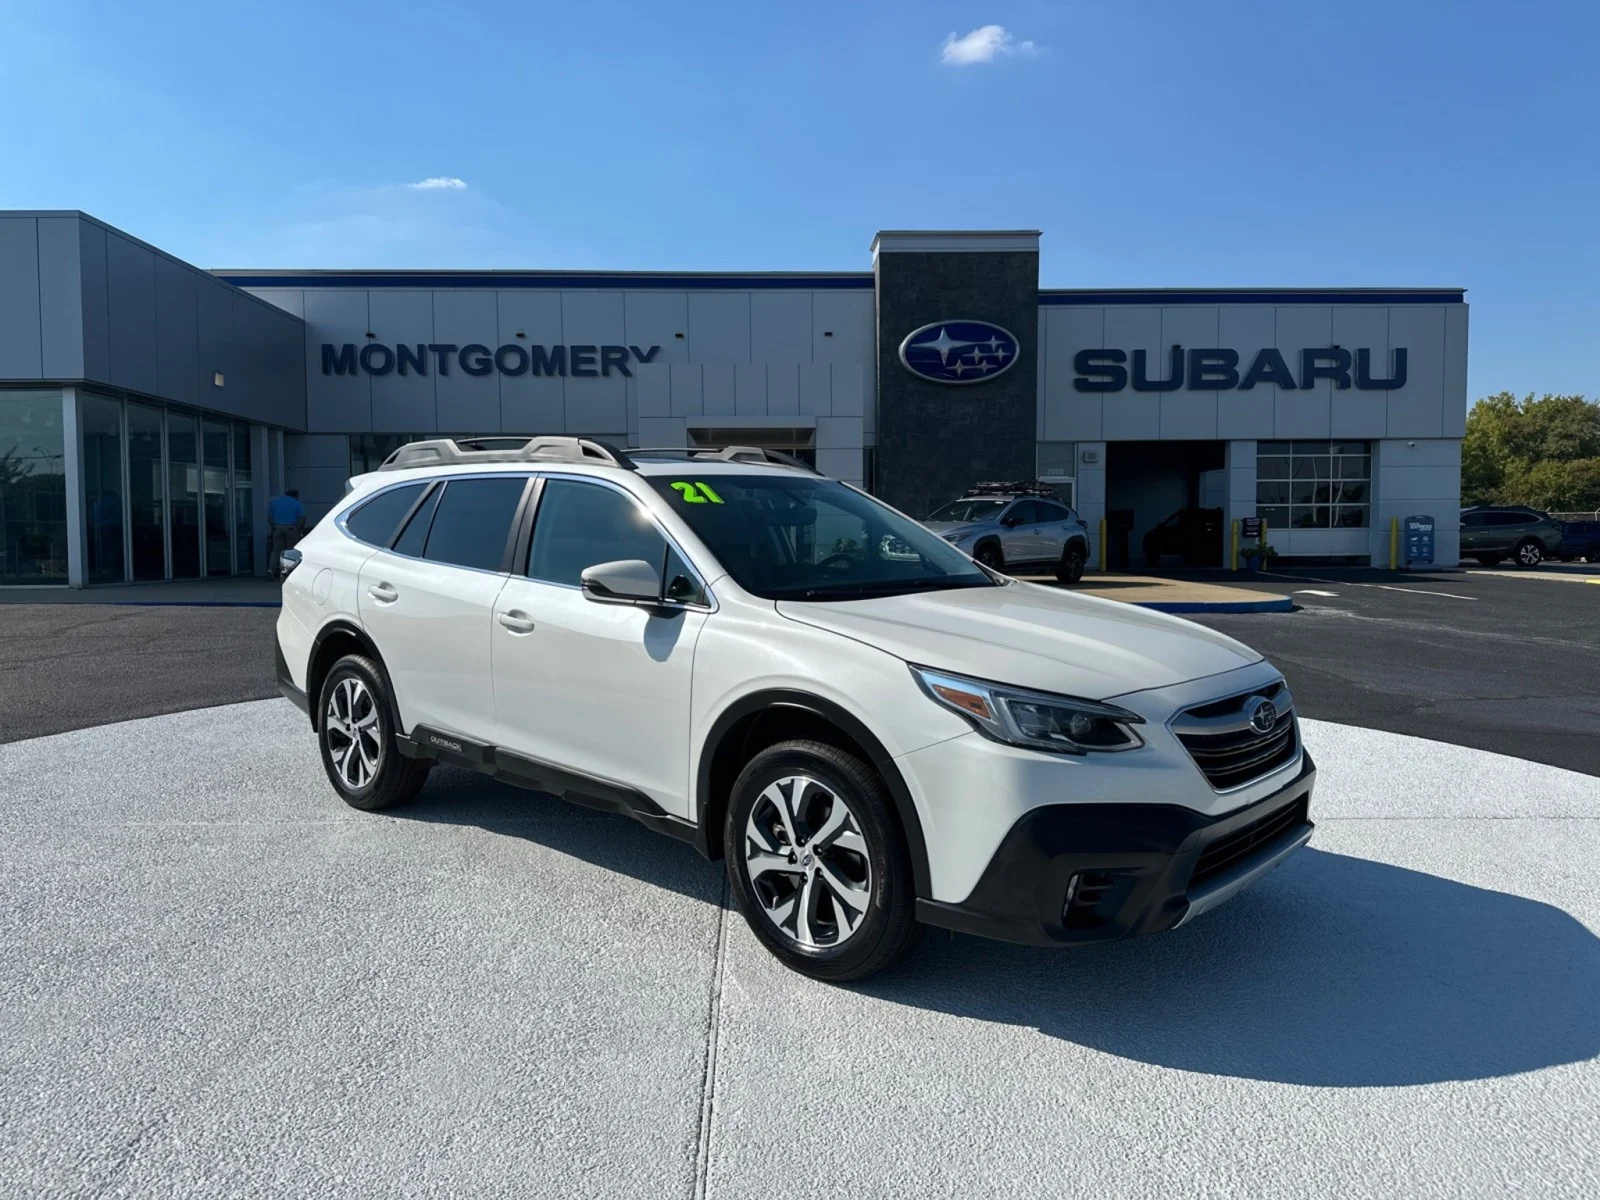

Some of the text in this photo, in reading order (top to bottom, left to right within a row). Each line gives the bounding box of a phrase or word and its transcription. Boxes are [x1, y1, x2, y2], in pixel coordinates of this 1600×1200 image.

[320, 343, 661, 377] MONTGOMERY
[1073, 347, 1408, 392] SUBARU
[670, 481, 725, 504] 21
[430, 735, 463, 752] OUTBACK
